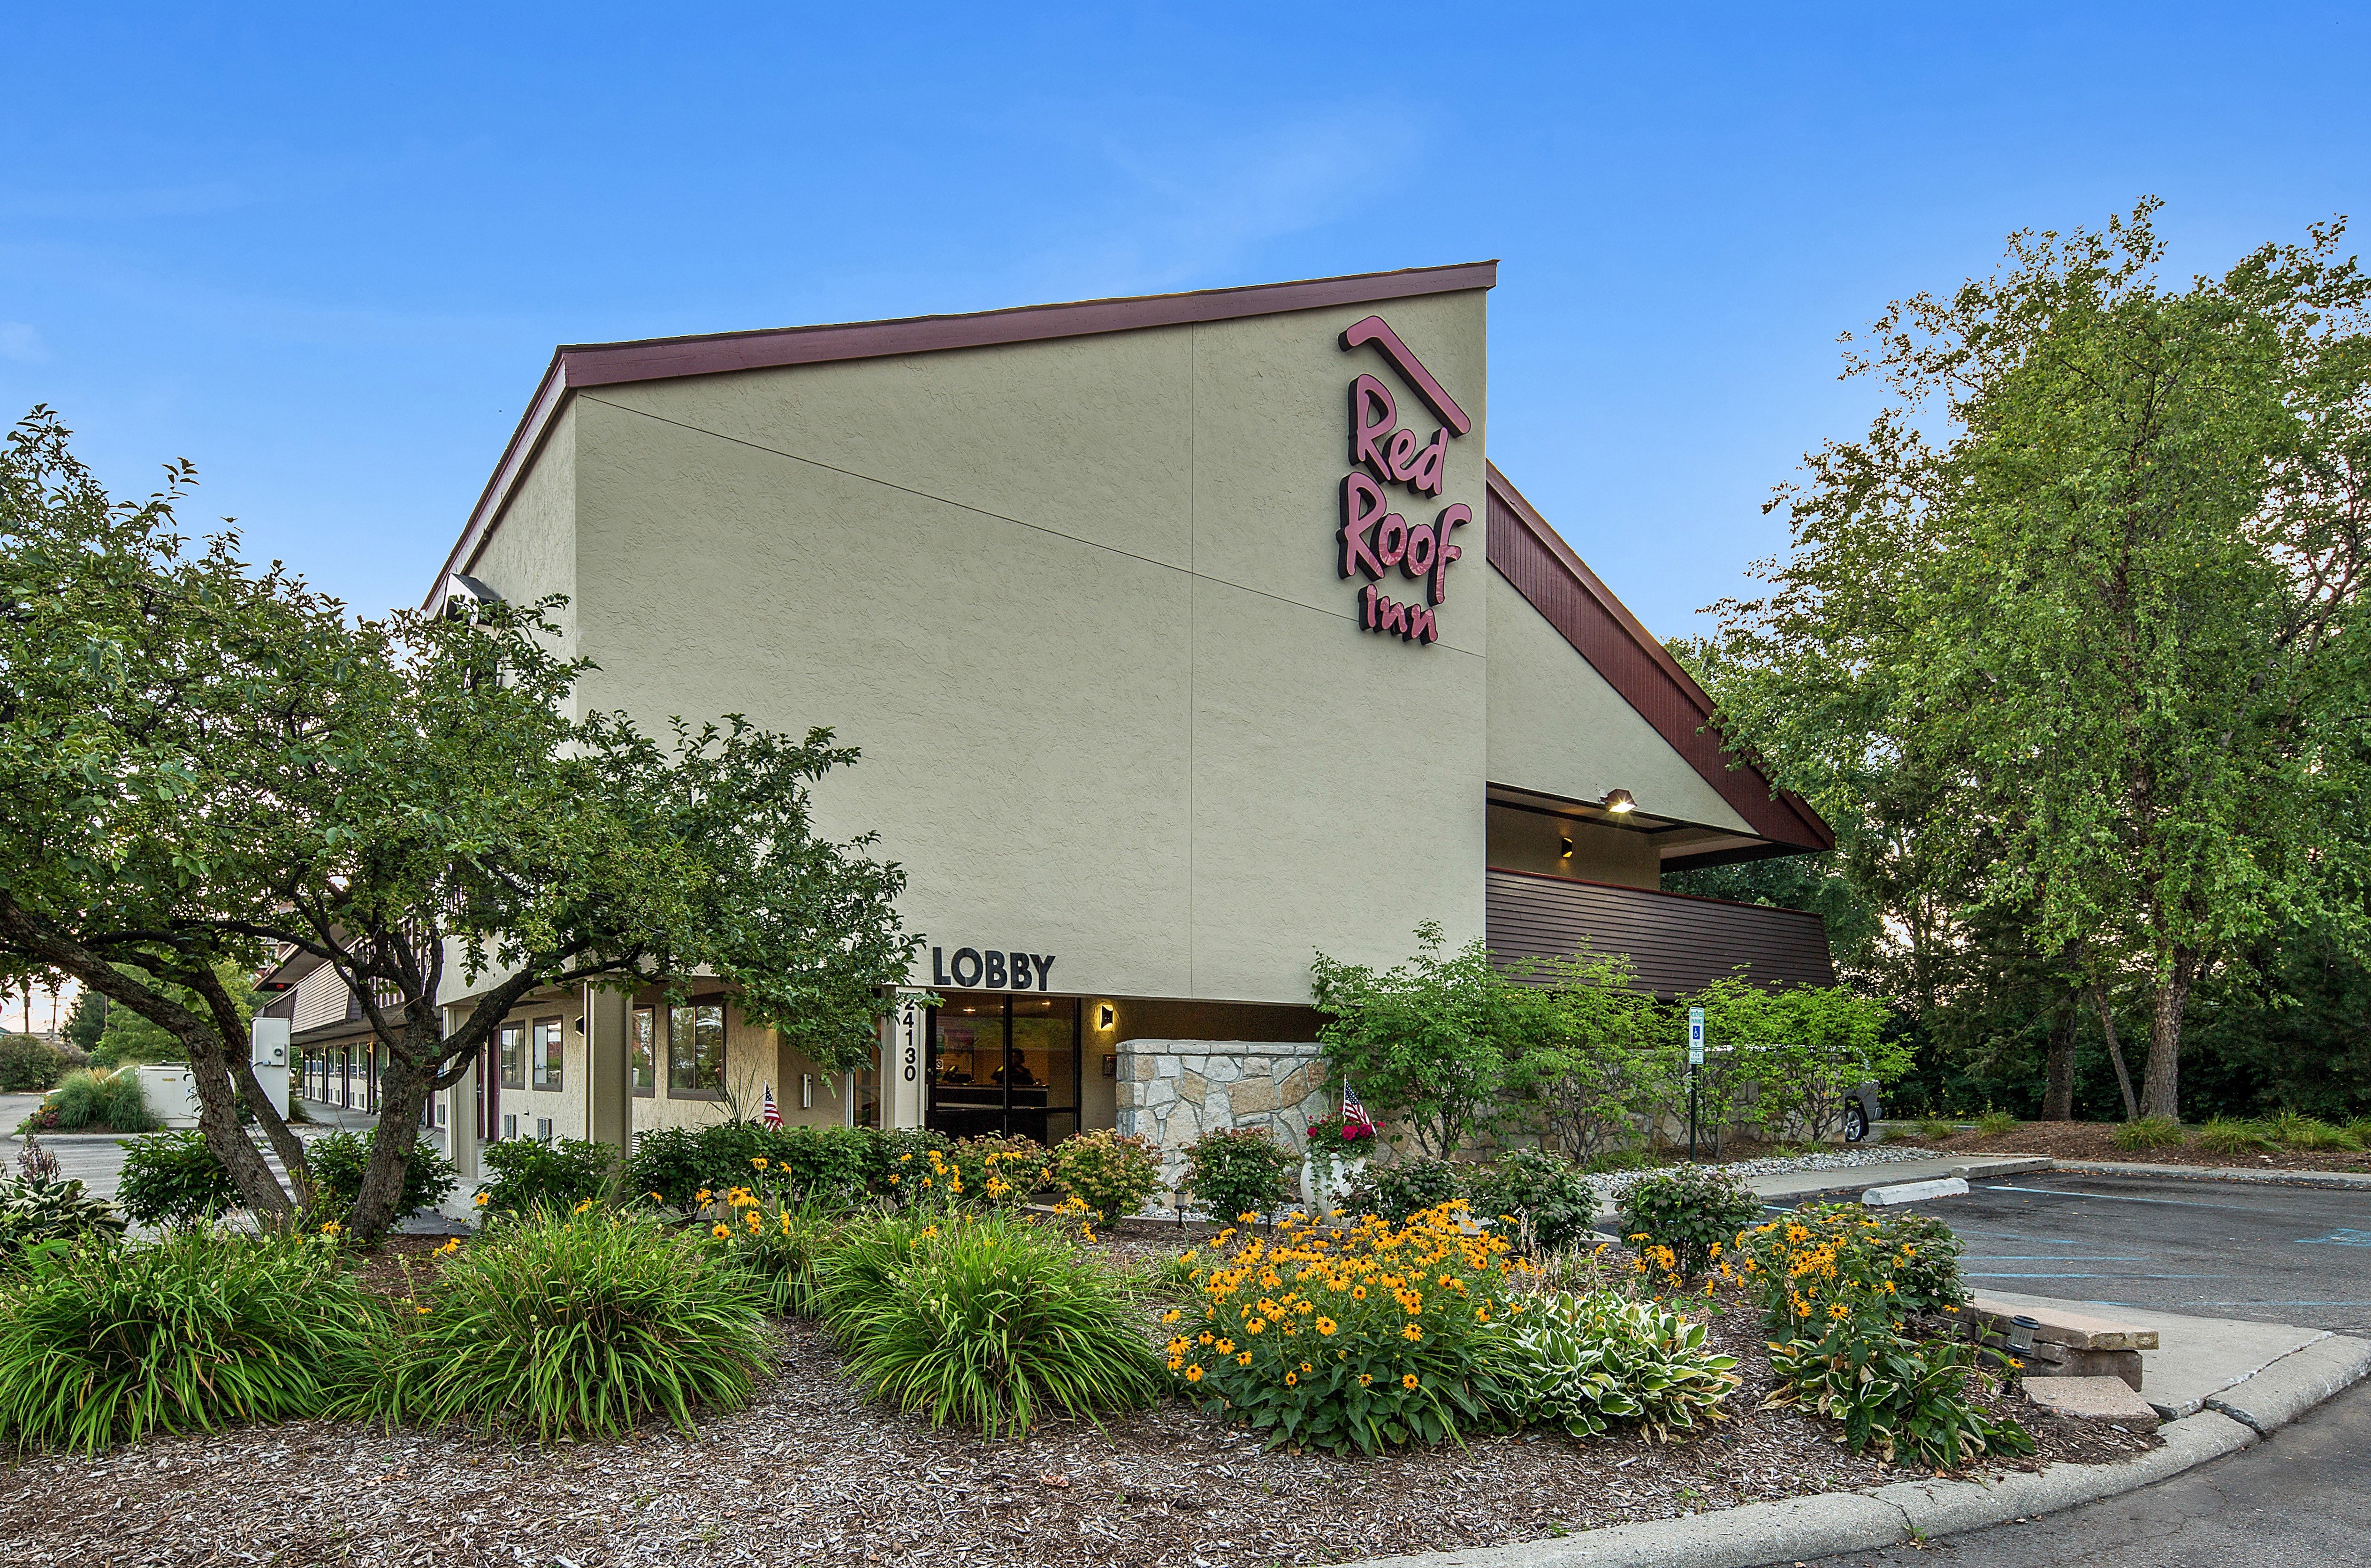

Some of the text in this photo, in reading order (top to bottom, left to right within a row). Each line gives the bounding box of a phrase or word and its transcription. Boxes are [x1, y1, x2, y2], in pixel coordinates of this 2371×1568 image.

[1348, 373, 1449, 499] Red
[1336, 472, 1472, 607] Roof
[933, 947, 1056, 991] LOBBY
[902, 994, 916, 1082] 24130
